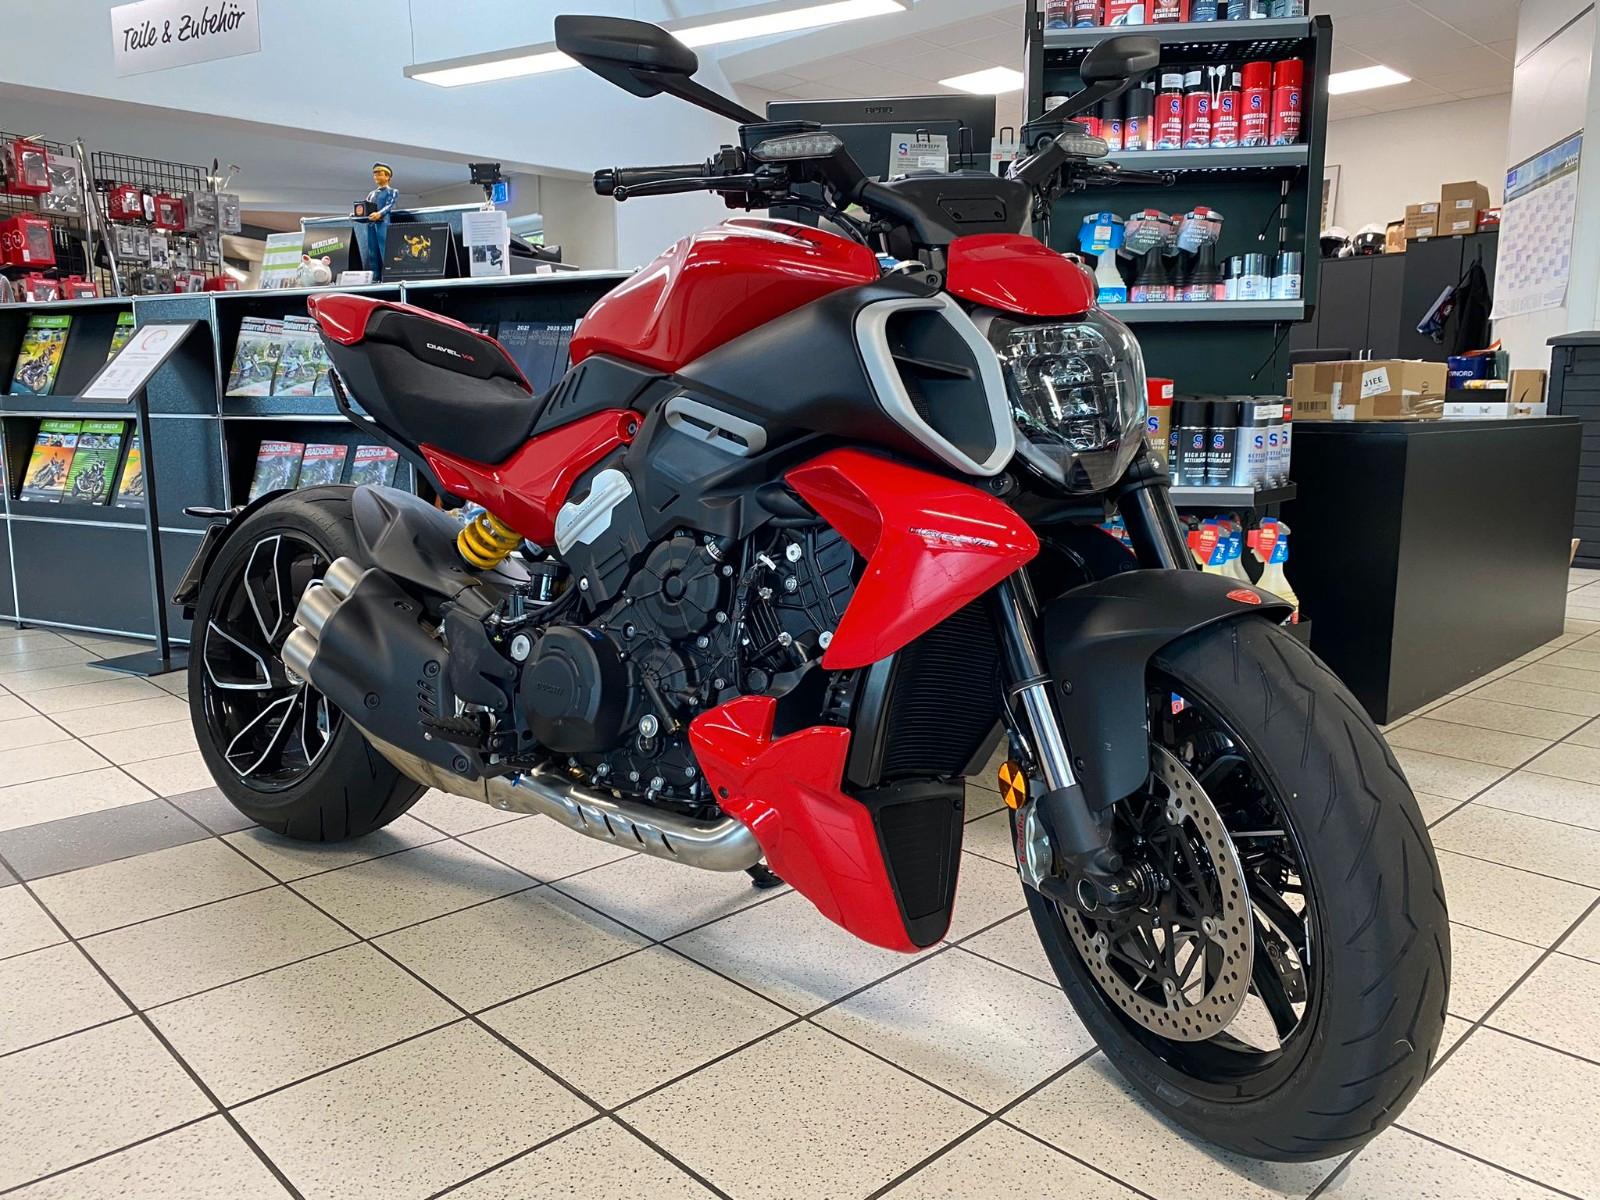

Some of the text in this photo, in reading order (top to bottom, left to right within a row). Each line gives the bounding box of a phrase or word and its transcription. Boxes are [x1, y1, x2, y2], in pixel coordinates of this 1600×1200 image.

[123, 1, 245, 52] Teile & Zubehör
[426, 342, 462, 358] DIAVEL
